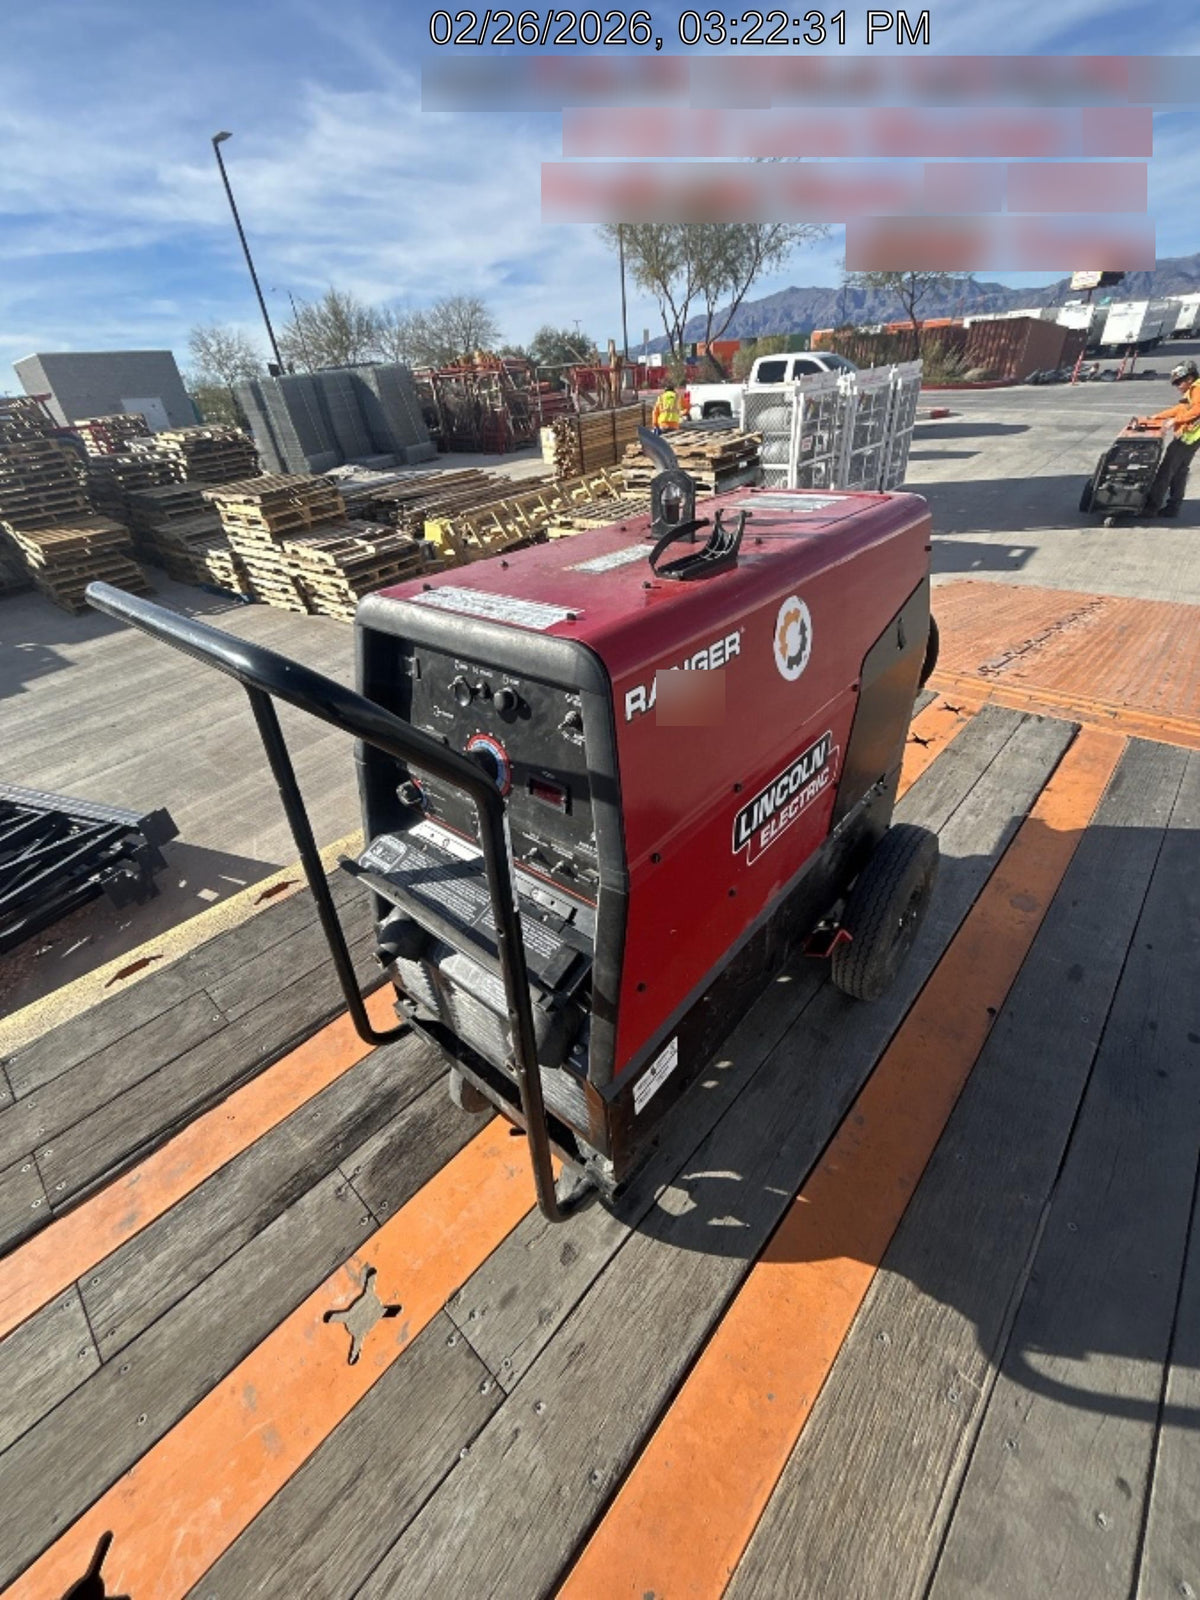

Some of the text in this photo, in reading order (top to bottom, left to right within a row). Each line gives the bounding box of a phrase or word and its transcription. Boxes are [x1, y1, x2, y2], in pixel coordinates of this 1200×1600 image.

[625, 630, 741, 721] RGER
[739, 741, 826, 843] LINCOLN
[760, 766, 829, 848] ELECTRIC
